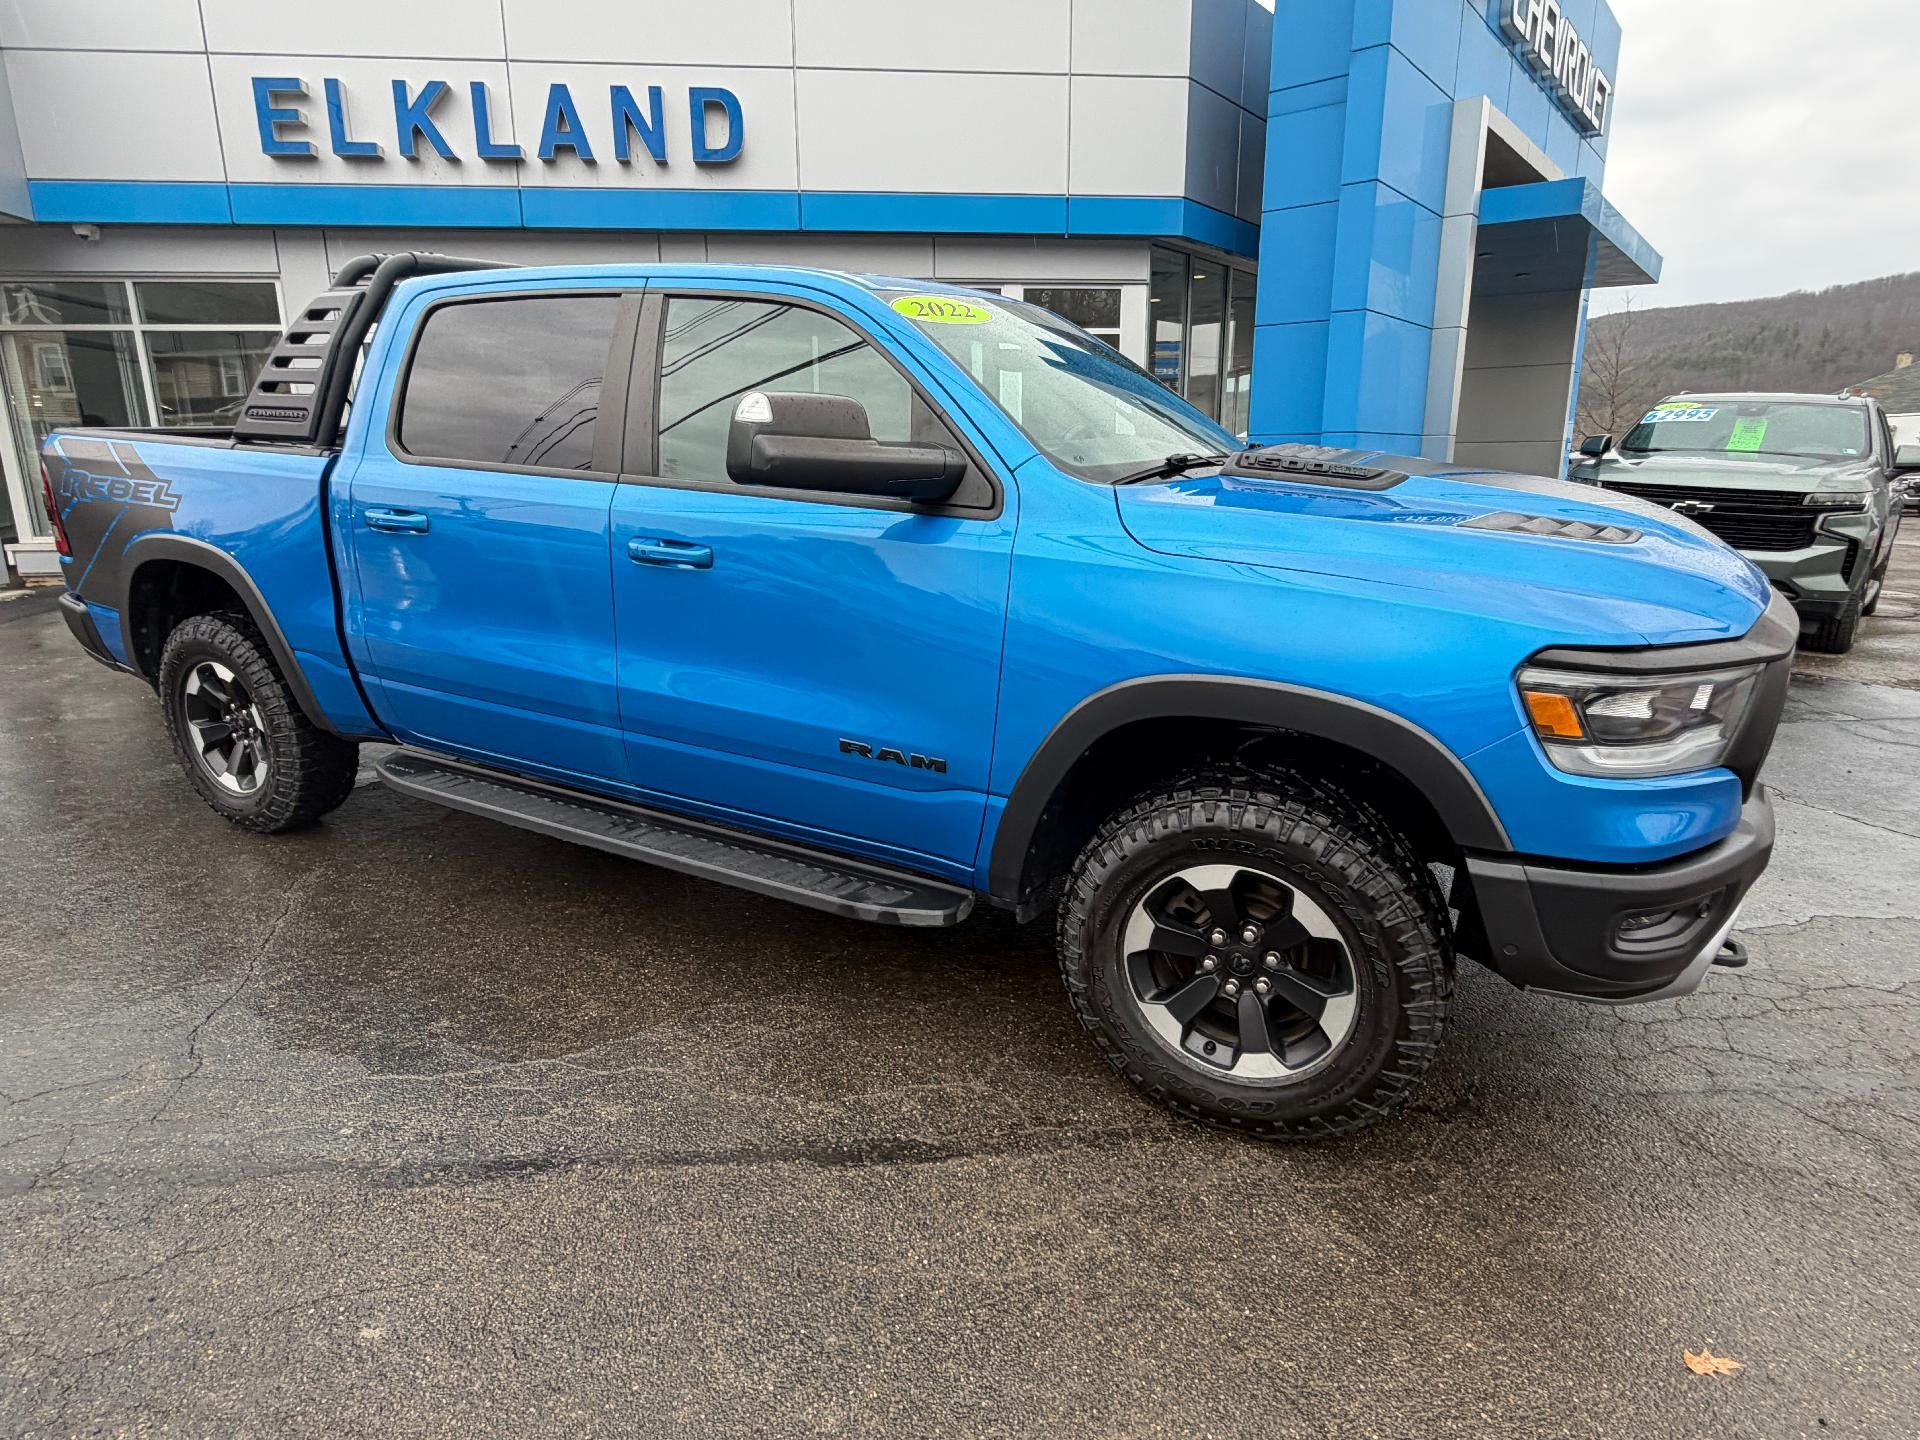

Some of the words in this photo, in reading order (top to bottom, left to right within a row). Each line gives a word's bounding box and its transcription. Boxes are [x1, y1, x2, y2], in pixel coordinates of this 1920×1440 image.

[251, 76, 746, 166] ELKLAND
[910, 301, 977, 318] 2022
[1644, 410, 1714, 422] 62995
[1244, 454, 1330, 473] 1500
[60, 468, 183, 512] REBEL
[839, 737, 947, 773] RAM
[1190, 838, 1390, 988] WRANGLER
[1091, 966, 1278, 1116] GOODYEAR
